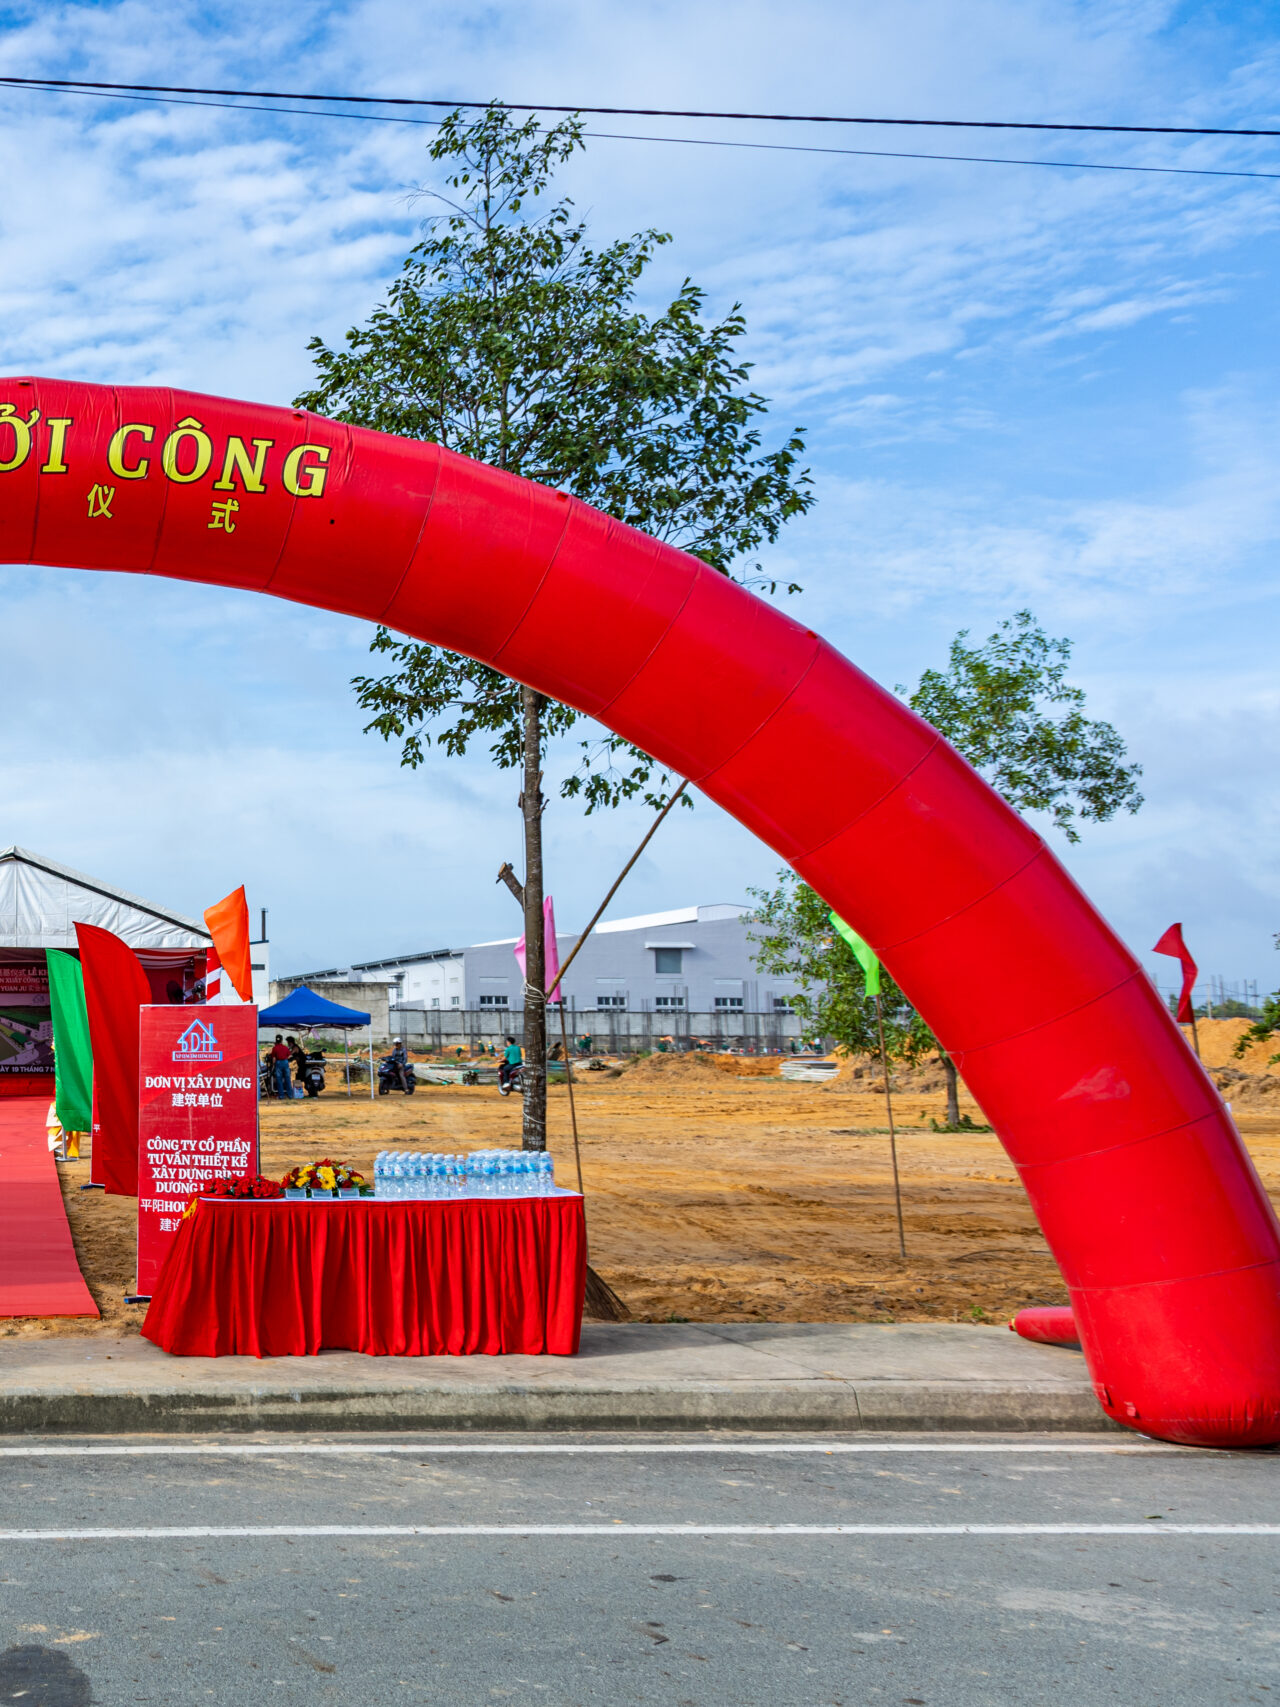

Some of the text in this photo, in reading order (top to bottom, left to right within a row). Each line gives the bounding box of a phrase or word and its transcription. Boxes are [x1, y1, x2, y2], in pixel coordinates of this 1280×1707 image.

[107, 417, 332, 498] CÔNG
[145, 1073, 251, 1092] ĐƠN VỊ XÂY DỰNG
[171, 1093, 223, 1107] 建筑单位
[147, 1135, 251, 1153] CÔNG TY CỔ PHẦN
[147, 1150, 248, 1168] TƯ VẤN THIẾT KẾ
[152, 1165, 177, 1179] XÂY
[178, 1167, 212, 1183] DỰNG
[156, 1181, 198, 1193] DƯƠNG
